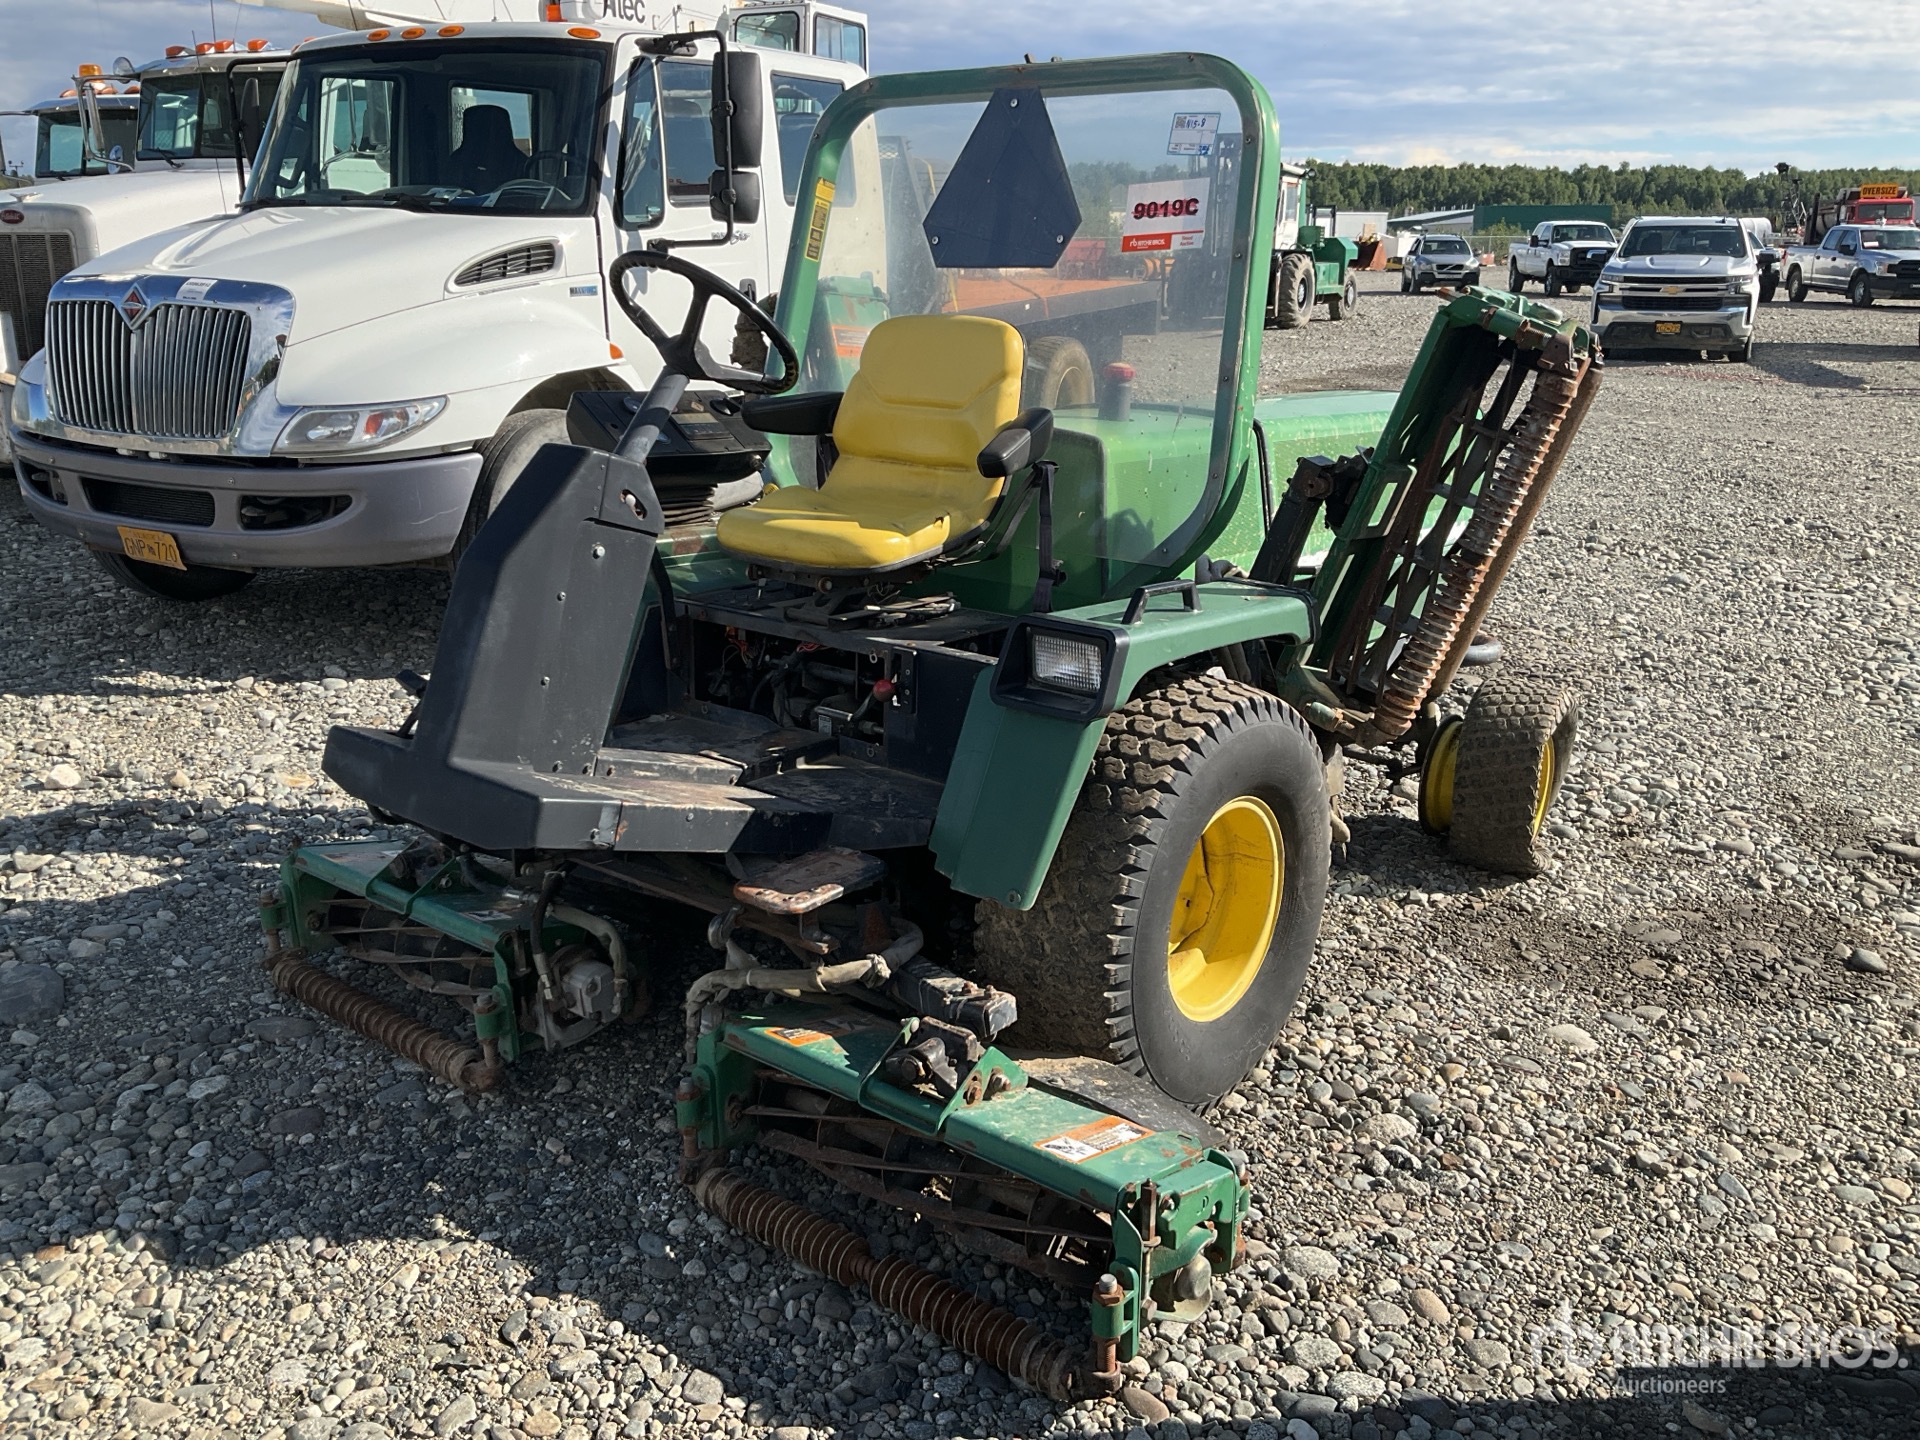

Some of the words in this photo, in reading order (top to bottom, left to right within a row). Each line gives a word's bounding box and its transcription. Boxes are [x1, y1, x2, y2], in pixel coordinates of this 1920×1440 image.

[1862, 186, 1896, 195] OVERSIZE
[1133, 198, 1199, 220] 9019C
[154, 541, 177, 562] 720
